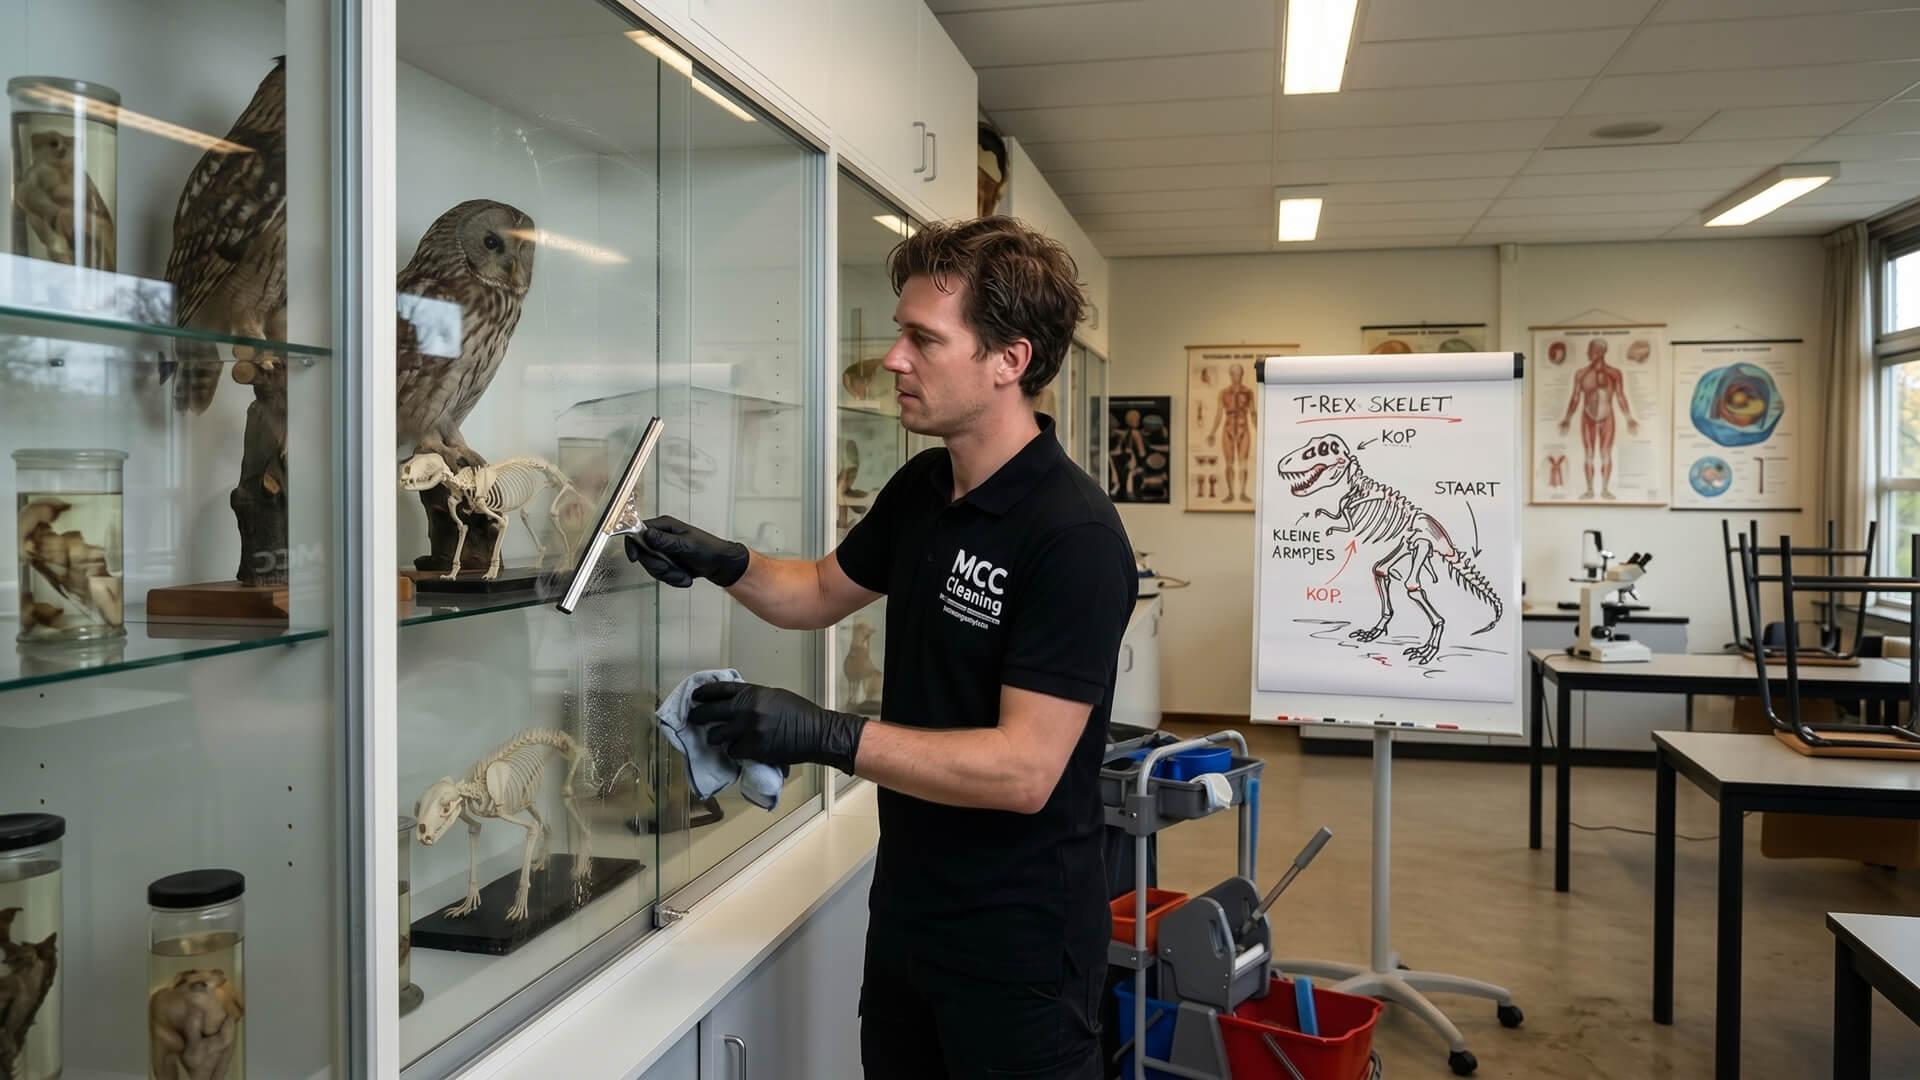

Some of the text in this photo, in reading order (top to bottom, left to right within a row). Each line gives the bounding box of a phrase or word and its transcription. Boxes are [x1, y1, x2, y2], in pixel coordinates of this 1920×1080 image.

[1293, 395, 1453, 414] T-REX SKELET
[1381, 428, 1417, 444] KOP
[1434, 480, 1501, 498] STAART
[1273, 528, 1321, 543] KLEINE
[1272, 545, 1336, 566] ARMPJES
[951, 548, 1008, 596] MCC
[945, 576, 1003, 617] Cleaning
